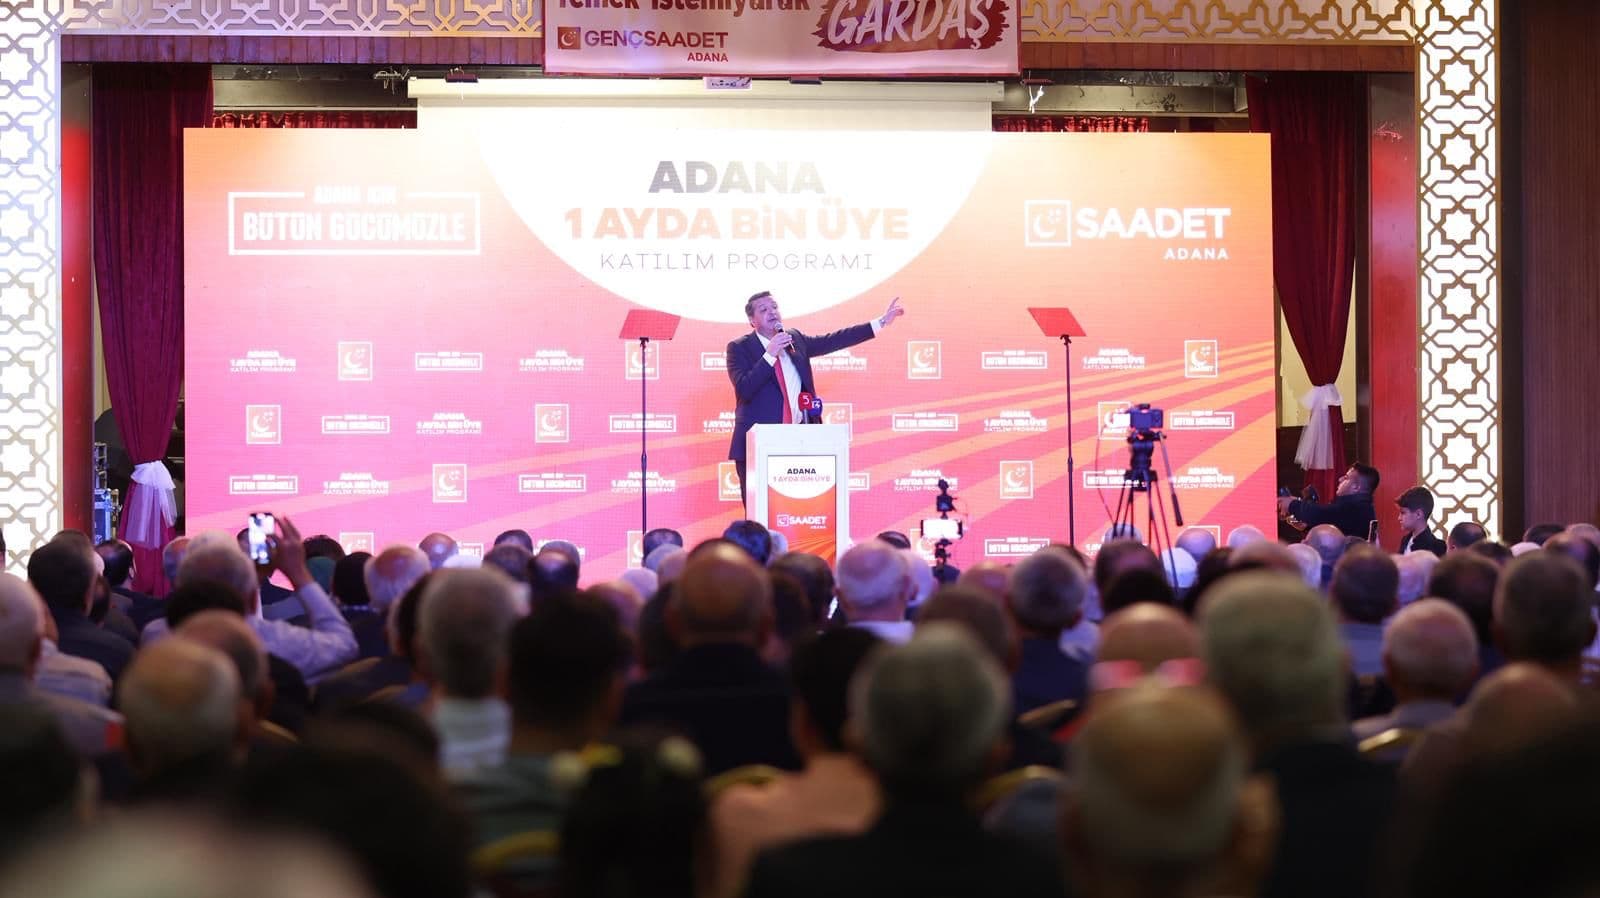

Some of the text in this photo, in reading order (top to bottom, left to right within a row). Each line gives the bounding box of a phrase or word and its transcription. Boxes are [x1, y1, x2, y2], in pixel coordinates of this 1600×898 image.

[687, 52, 729, 63] ADANA
[648, 160, 825, 194] ADANA
[564, 207, 582, 240] 1
[592, 207, 721, 240] AYDA
[817, 197, 910, 240] ÜYE
[1075, 206, 1232, 240] SAADET
[1163, 247, 1229, 260] ADANA
[600, 253, 873, 270] KATILIM PROGRAMI
[787, 467, 817, 475] ADANA
[789, 515, 827, 525] SAADET
